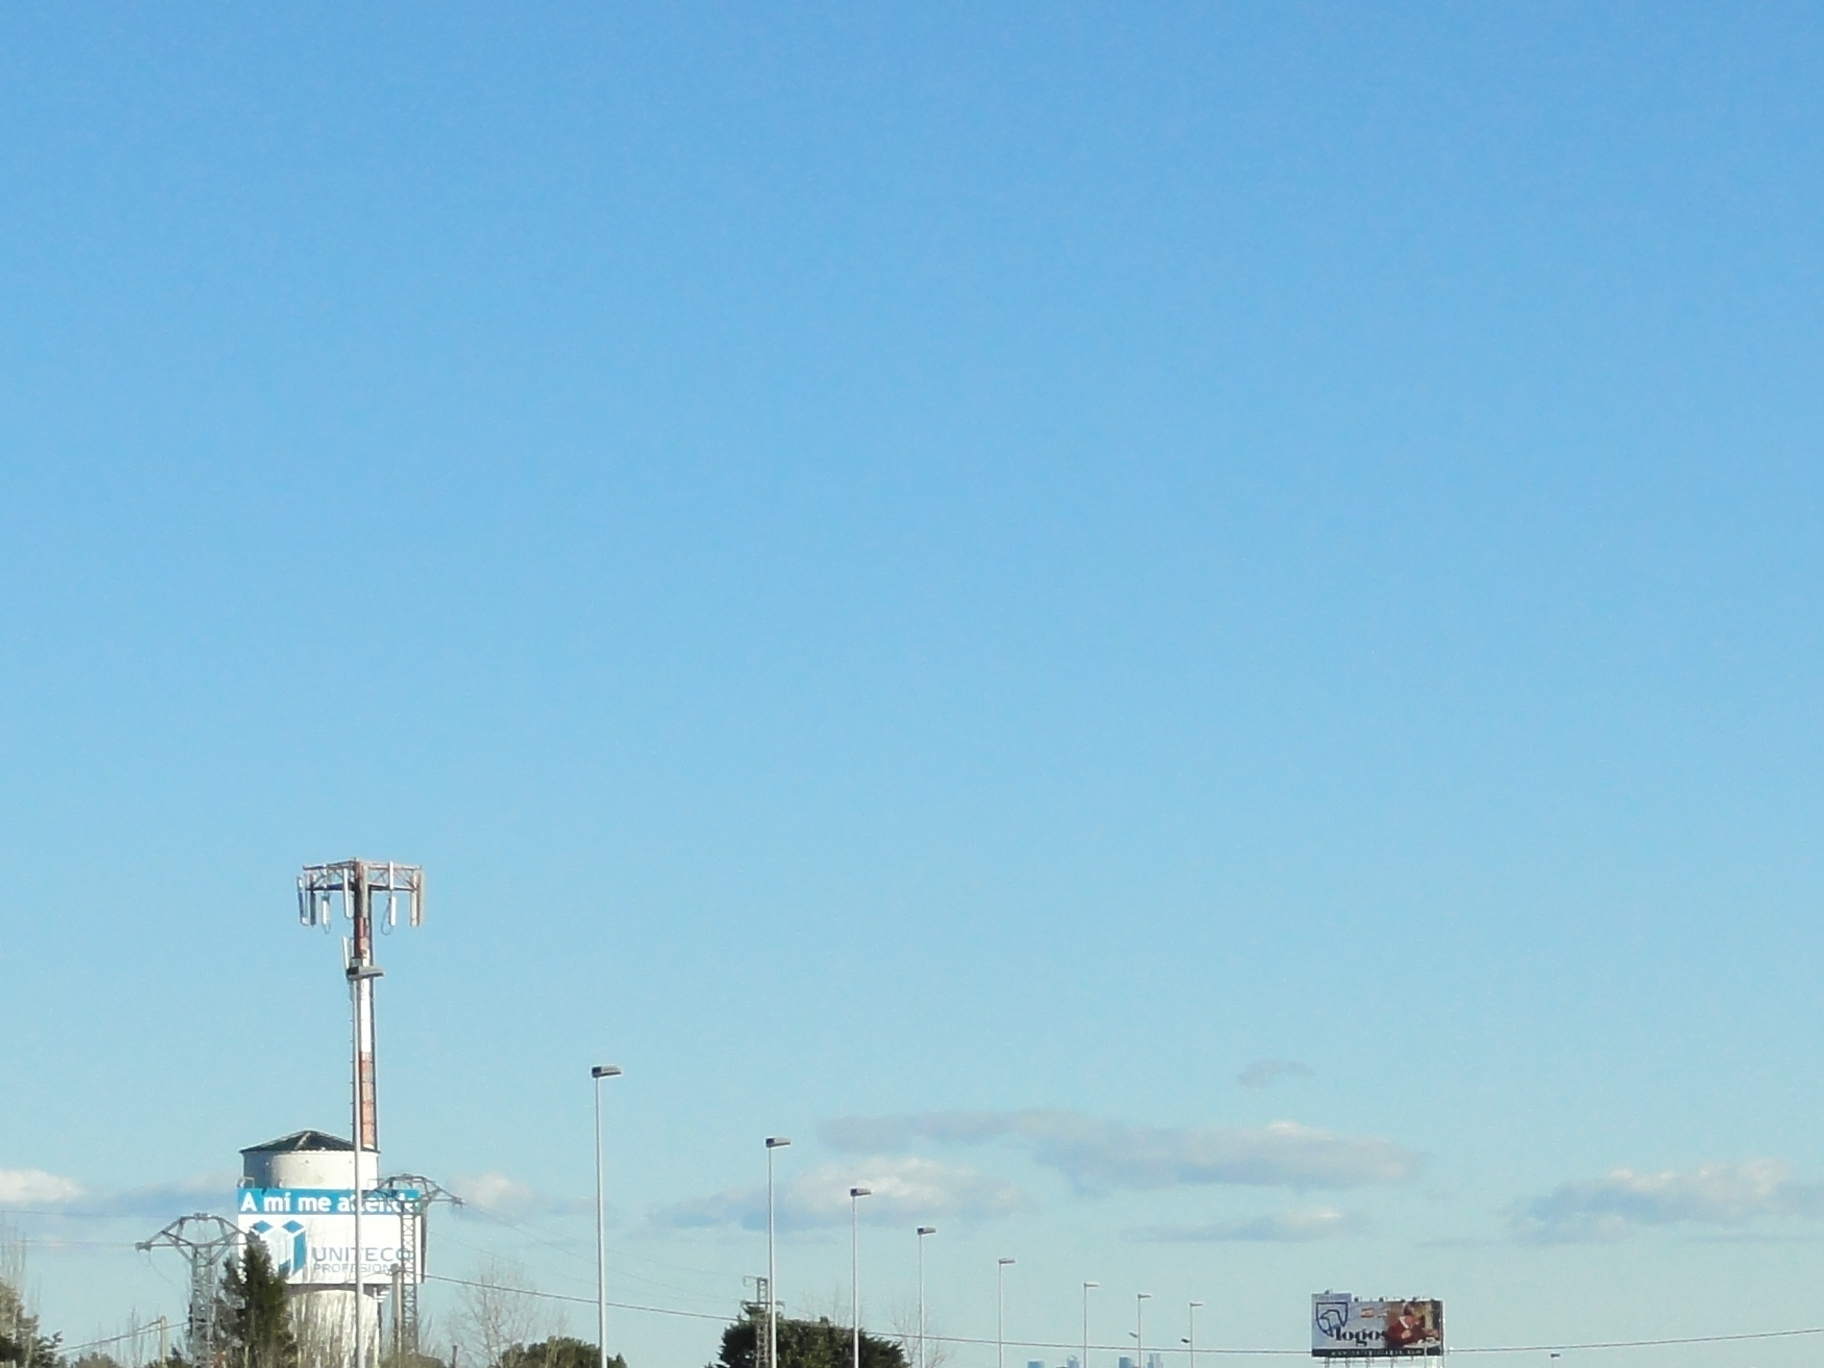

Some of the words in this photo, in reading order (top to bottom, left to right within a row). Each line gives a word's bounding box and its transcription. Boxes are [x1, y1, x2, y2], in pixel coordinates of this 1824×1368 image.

[241, 1192, 258, 1212] A
[263, 1192, 291, 1212] mí
[298, 1197, 332, 1212] me
